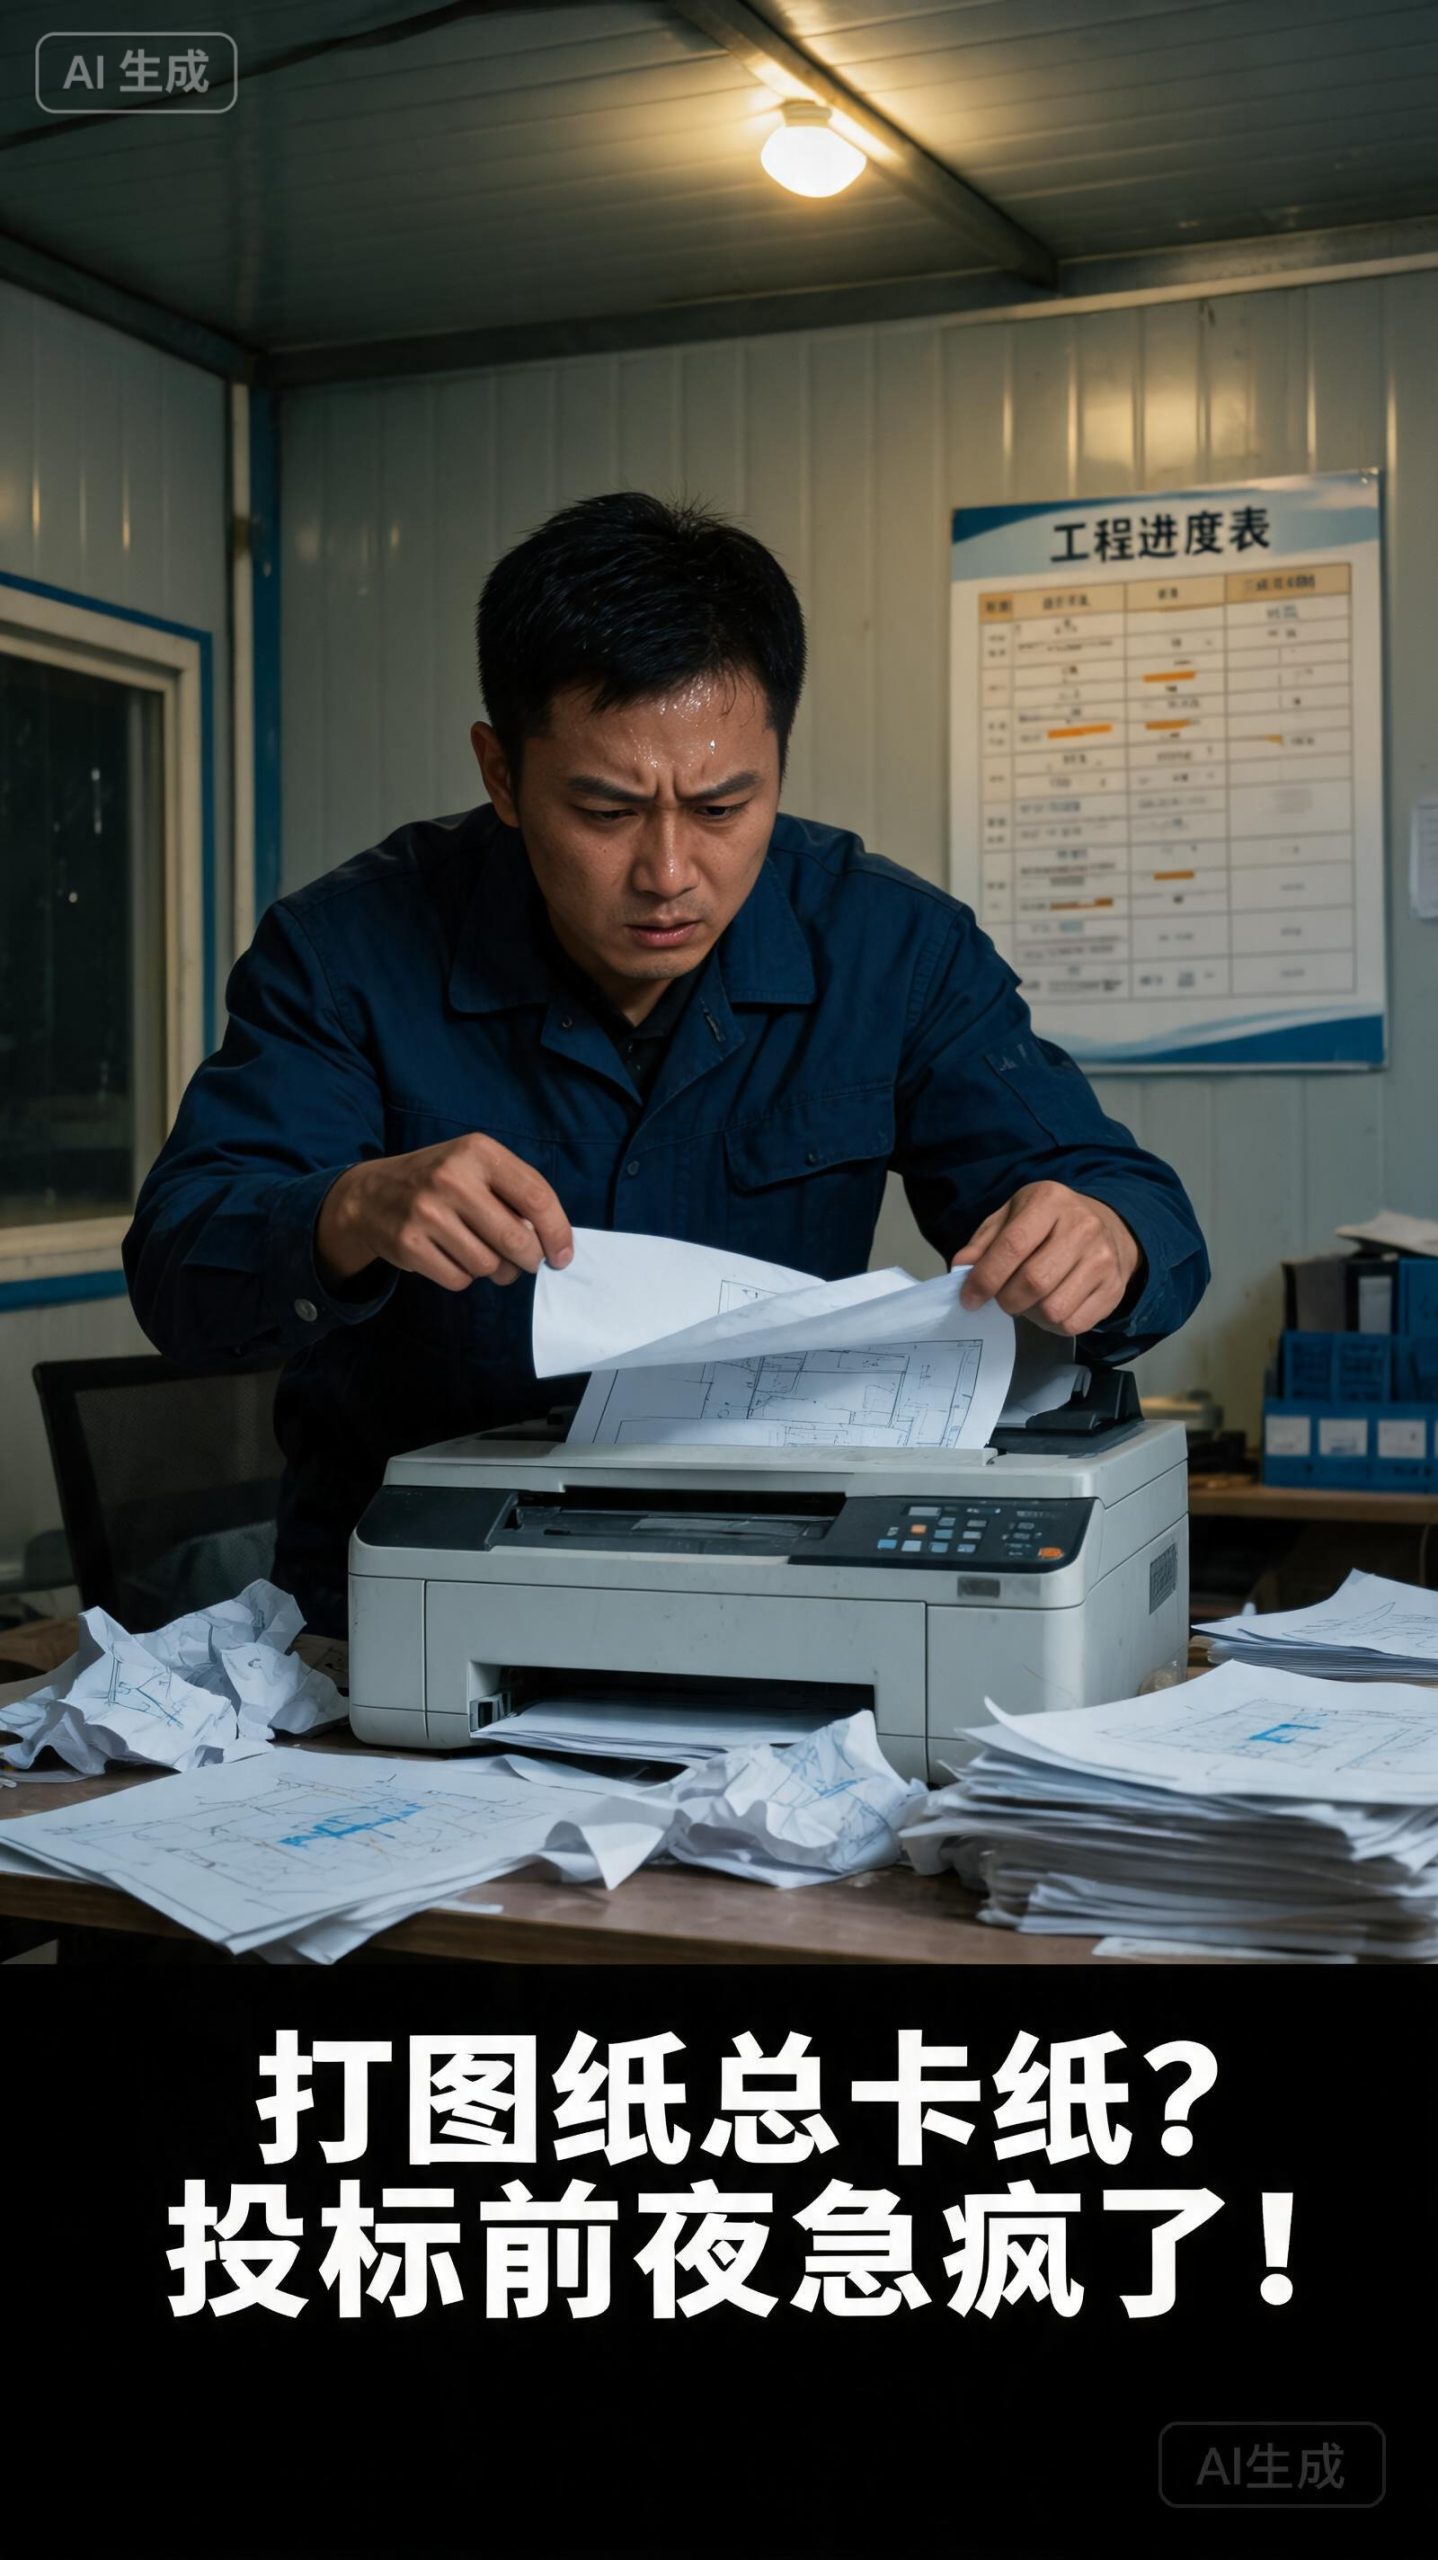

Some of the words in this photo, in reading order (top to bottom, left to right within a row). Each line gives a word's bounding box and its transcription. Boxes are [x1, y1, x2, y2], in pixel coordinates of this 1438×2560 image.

[1051, 506, 1270, 563] 工程进度表
